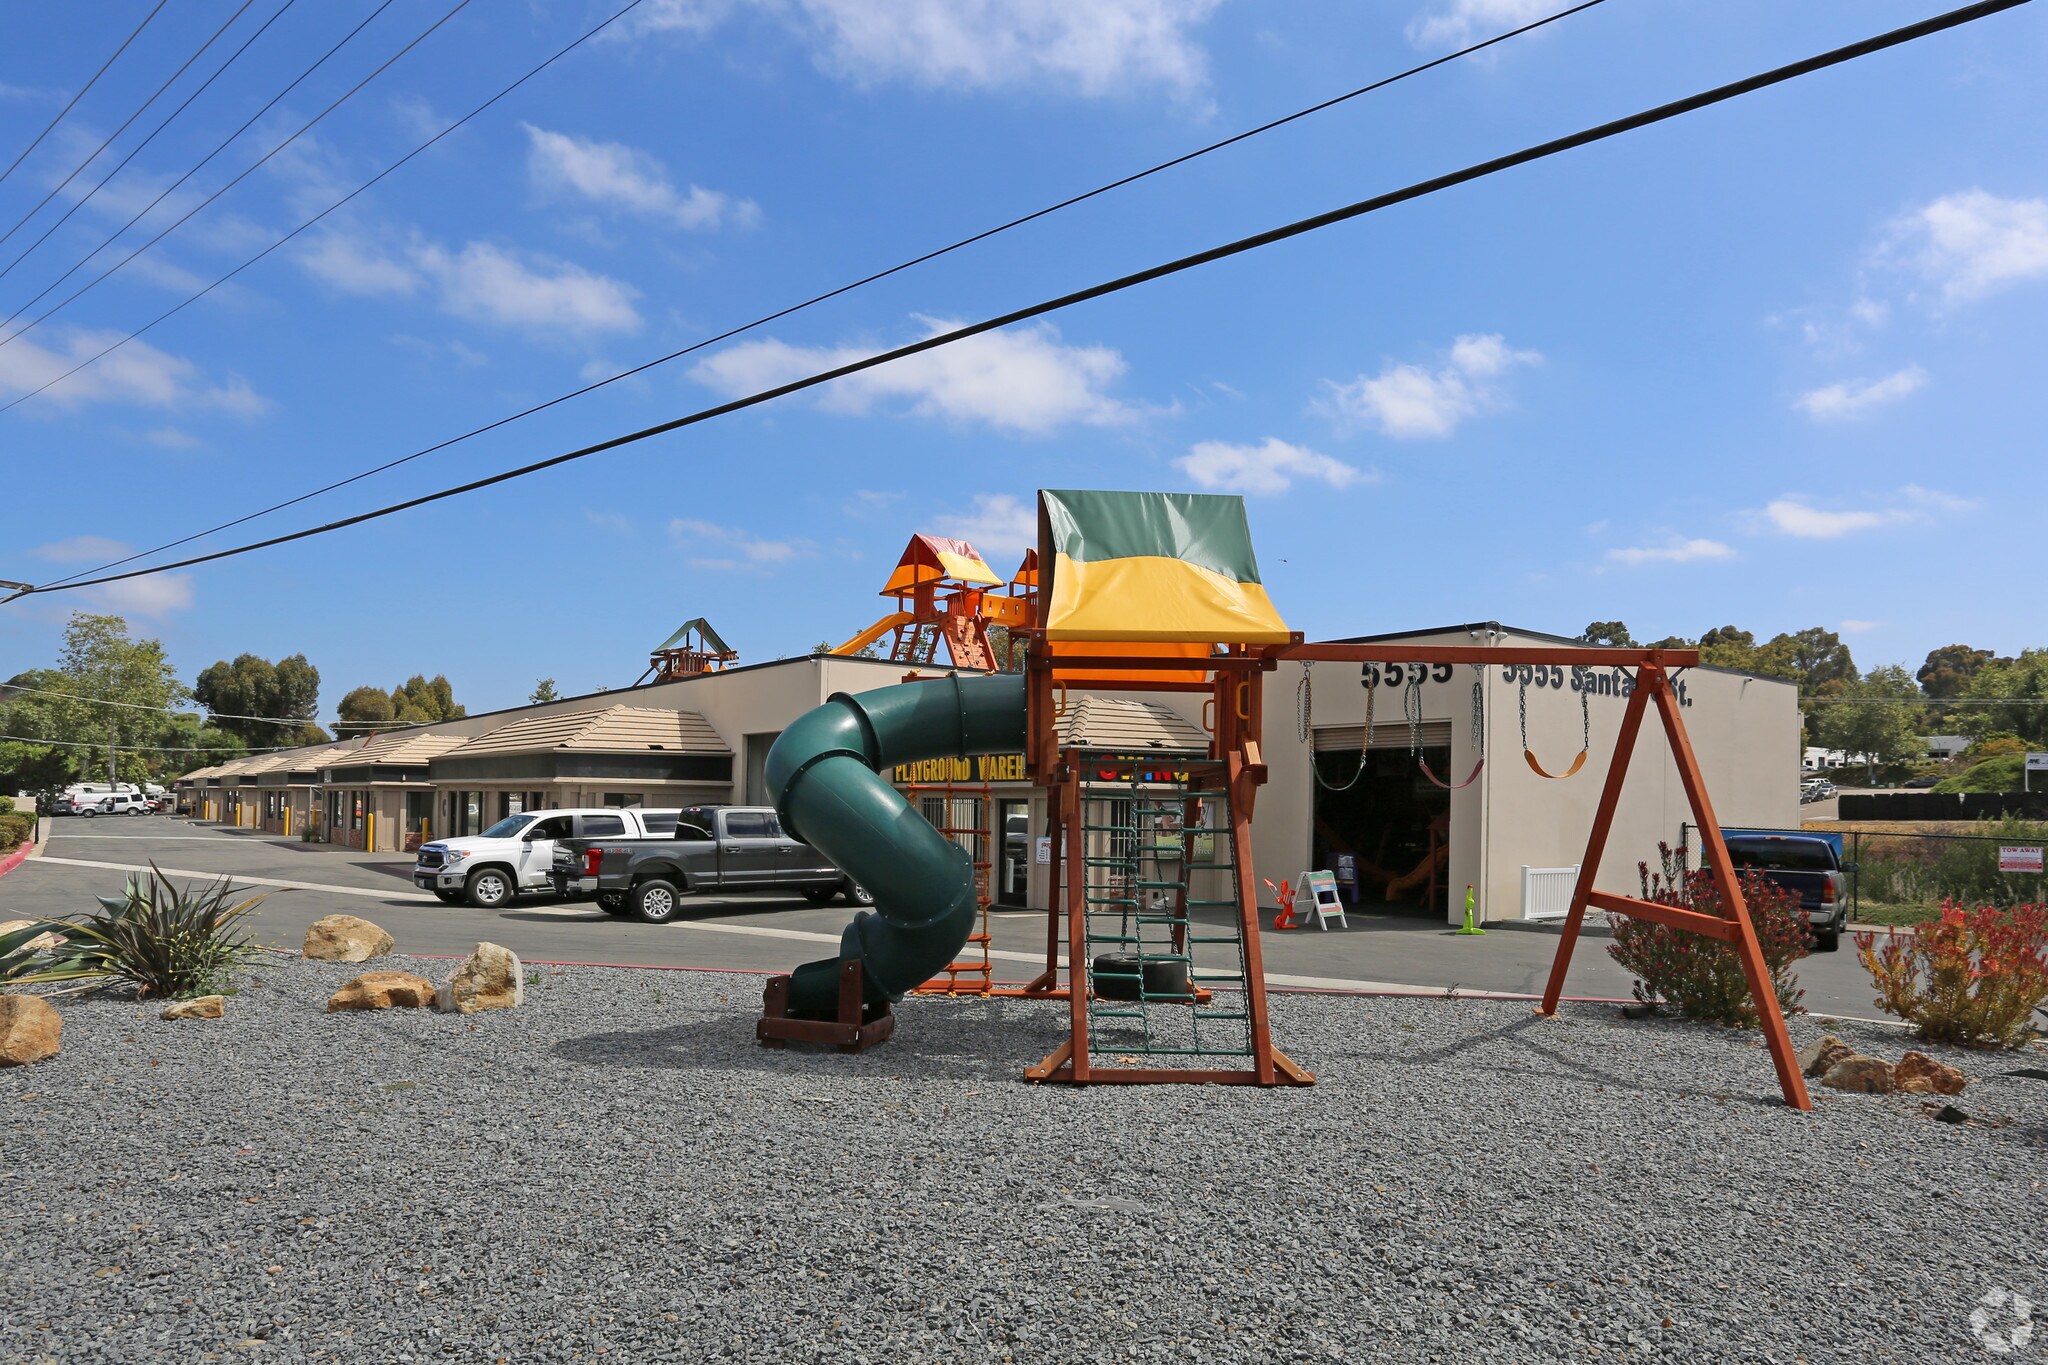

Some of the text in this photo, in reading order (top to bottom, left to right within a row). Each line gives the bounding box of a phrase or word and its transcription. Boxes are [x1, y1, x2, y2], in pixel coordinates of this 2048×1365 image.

[1361, 662, 1453, 689] 5555
[1570, 664, 1637, 698] Santa
[895, 755, 1025, 782] PLAYGROUND WAREH
